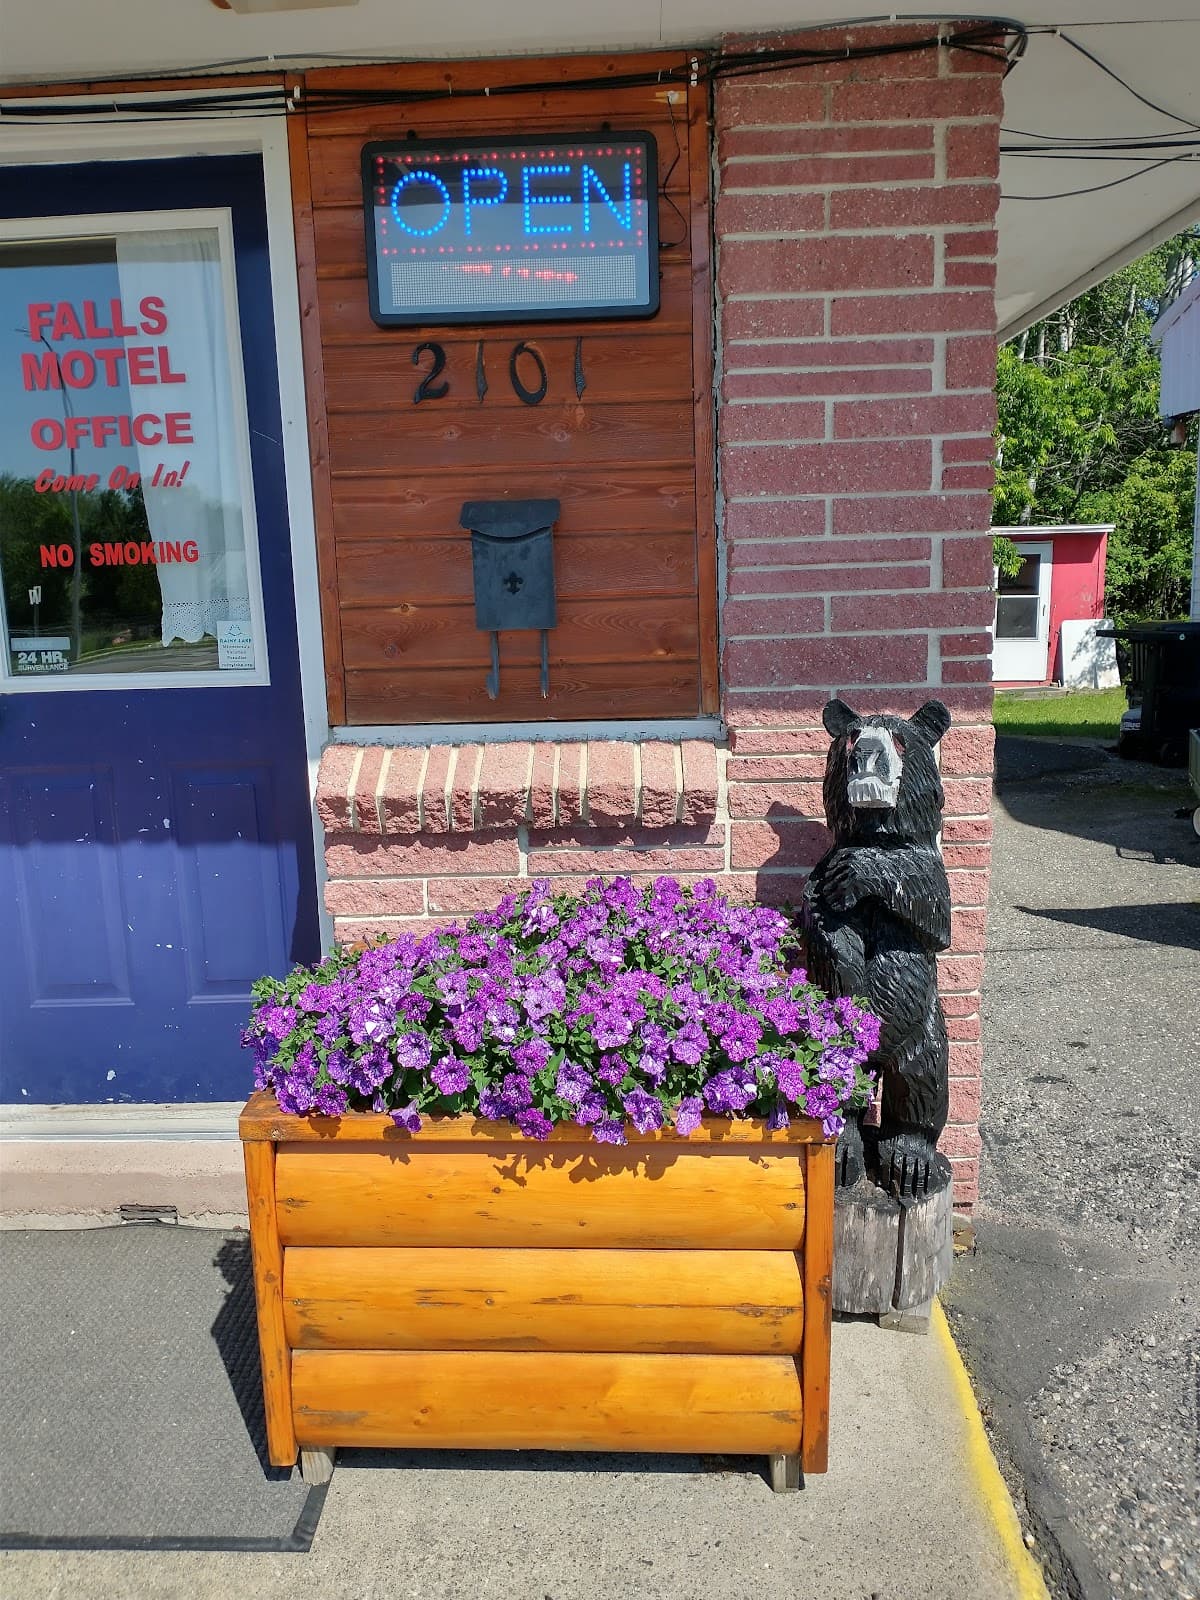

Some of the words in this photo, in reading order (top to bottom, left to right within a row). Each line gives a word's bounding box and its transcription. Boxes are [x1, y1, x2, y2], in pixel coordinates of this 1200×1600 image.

[391, 162, 632, 237] OPEN
[28, 296, 168, 342] FALLS
[21, 345, 186, 391] MOTEL
[411, 336, 586, 405] 2101
[31, 412, 194, 450] OFFICE
[34, 467, 99, 493] Come
[108, 465, 141, 490] On
[151, 460, 190, 487] In!
[40, 544, 74, 567] NO
[90, 540, 199, 566] SMOKING
[17, 651, 38, 664] 24
[18, 662, 69, 672] SURVEILLANCE
